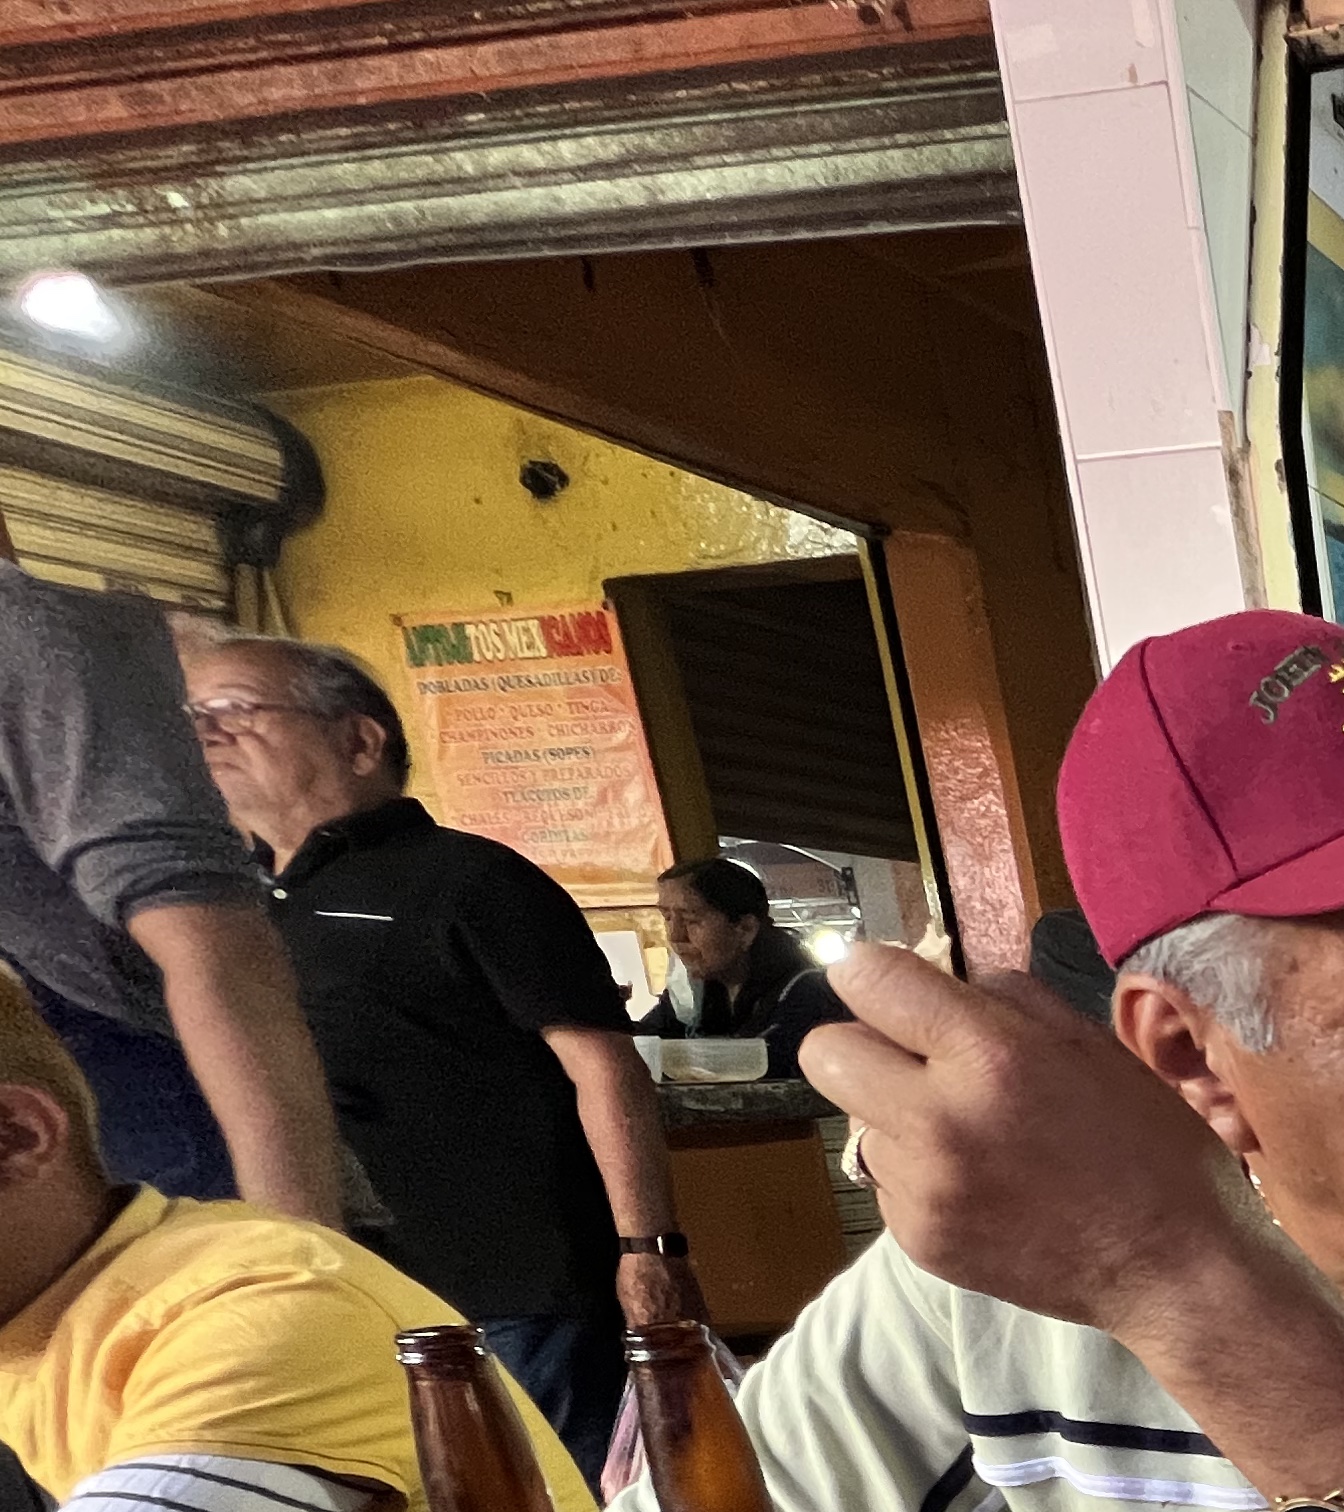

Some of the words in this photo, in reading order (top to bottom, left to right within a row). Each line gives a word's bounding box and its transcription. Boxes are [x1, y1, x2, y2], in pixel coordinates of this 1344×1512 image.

[510, 702, 554, 721] QUESO
[566, 700, 609, 715] TINGA
[481, 749, 541, 764] PICADAS
